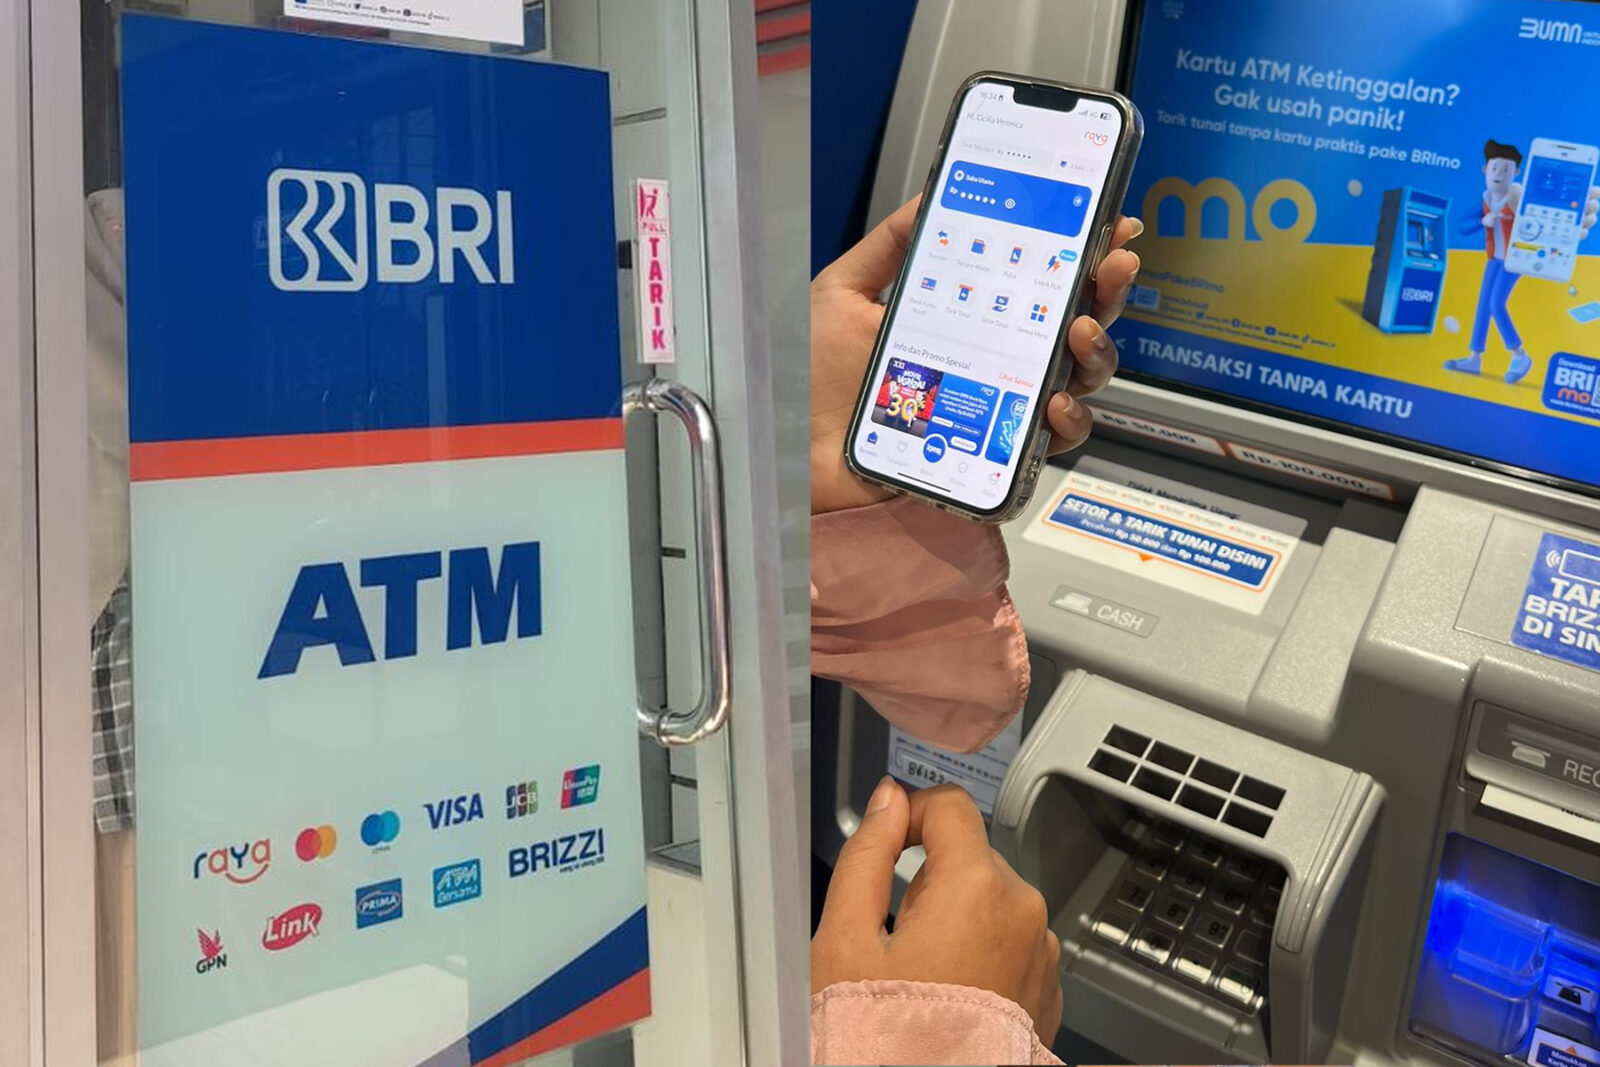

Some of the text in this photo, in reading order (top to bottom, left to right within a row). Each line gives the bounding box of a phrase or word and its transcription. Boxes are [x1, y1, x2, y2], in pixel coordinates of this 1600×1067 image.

[1519, 18, 1583, 44] BUMN
[1176, 48, 1460, 106] Kartu ATM Ketinggalan?
[1214, 84, 1405, 131] Gak usah panik!
[1156, 110, 1461, 169] Tarik tunai tanpa kartu praktis pake BRImo
[1143, 177, 1317, 248] mo
[374, 183, 515, 284] BRI
[649, 238, 665, 350] TARIK
[893, 341, 971, 370] Info dan Promo Spesial
[1558, 357, 1596, 372] Download
[1137, 336, 1413, 419] TRANSAKSI TANPA KARTU
[1553, 366, 1594, 392] BRI
[1558, 387, 1591, 405] mo
[1062, 497, 1110, 521] SETOR
[1109, 511, 1123, 525] &
[1125, 516, 1168, 539] TARIK
[1168, 530, 1217, 554] TUNAI
[1217, 545, 1268, 570] DISINI
[1080, 518, 1231, 572] Pecahan Rp 50.000 dan Rp 100.000
[257, 541, 542, 679] ATM
[1097, 604, 1145, 631] CASH
[1522, 615, 1553, 639] DI
[1524, 594, 1600, 630] BRIZ
[423, 793, 484, 830] VISA
[506, 791, 538, 809] JCB
[194, 838, 270, 884] raya
[509, 828, 604, 878] BRIZZI
[360, 895, 398, 913] PRIMA
[265, 911, 320, 942] Link
[1208, 921, 1220, 937] 9
[196, 953, 227, 974] GPN
